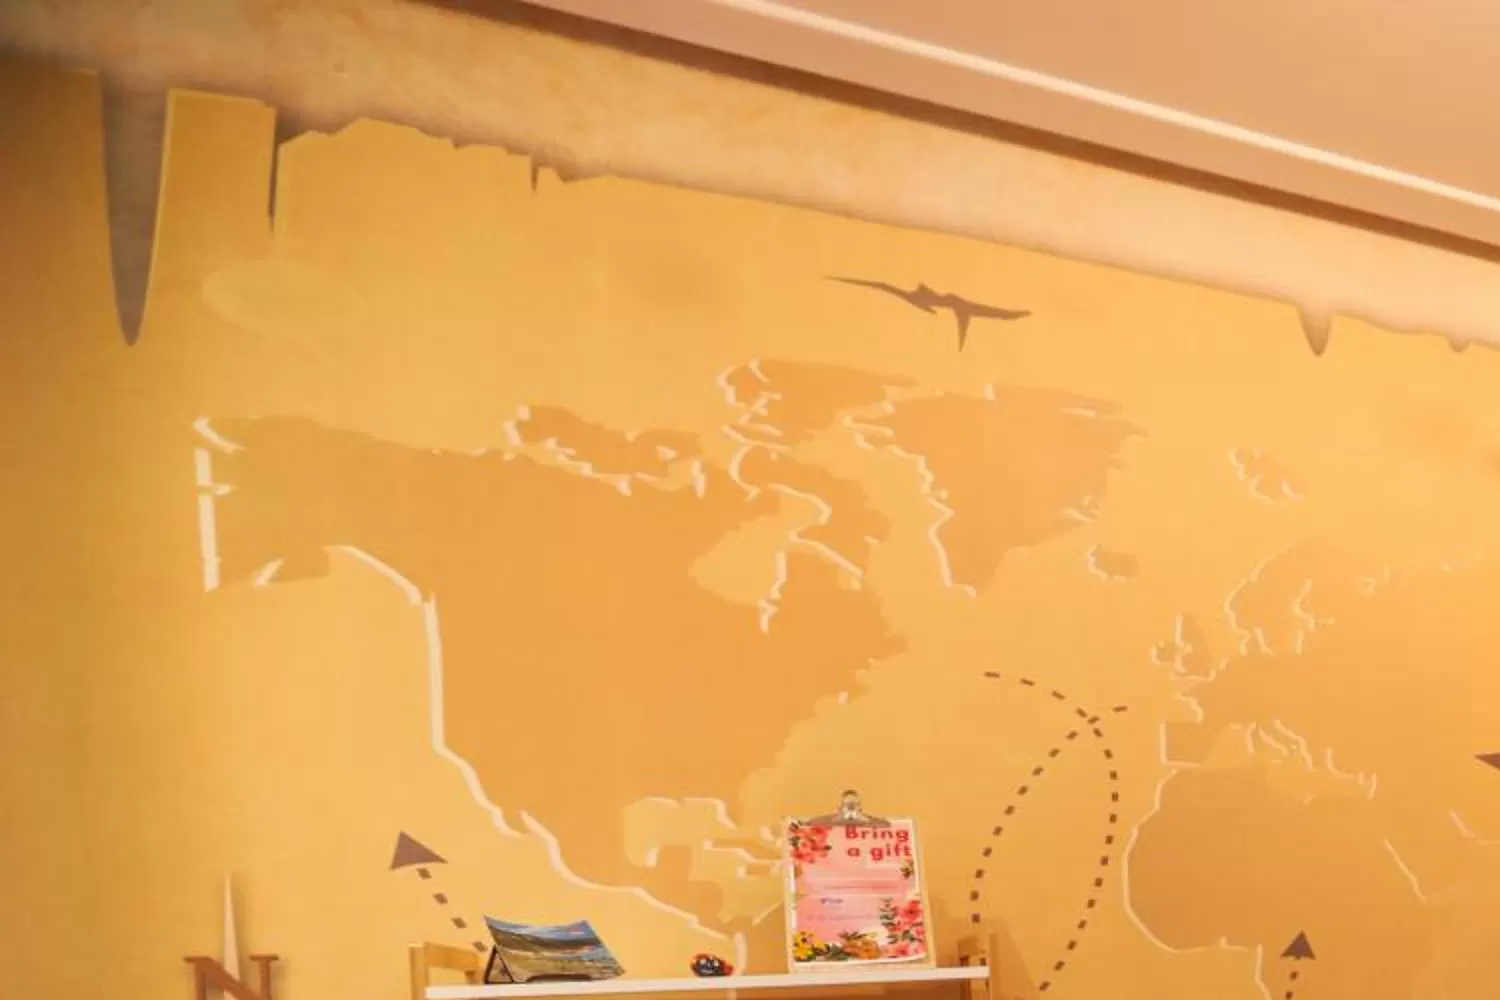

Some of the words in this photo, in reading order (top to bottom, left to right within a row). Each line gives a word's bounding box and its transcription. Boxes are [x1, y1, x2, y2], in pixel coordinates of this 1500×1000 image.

[845, 825, 909, 842] Bring
[847, 846, 861, 857] a
[869, 843, 912, 861] gift
